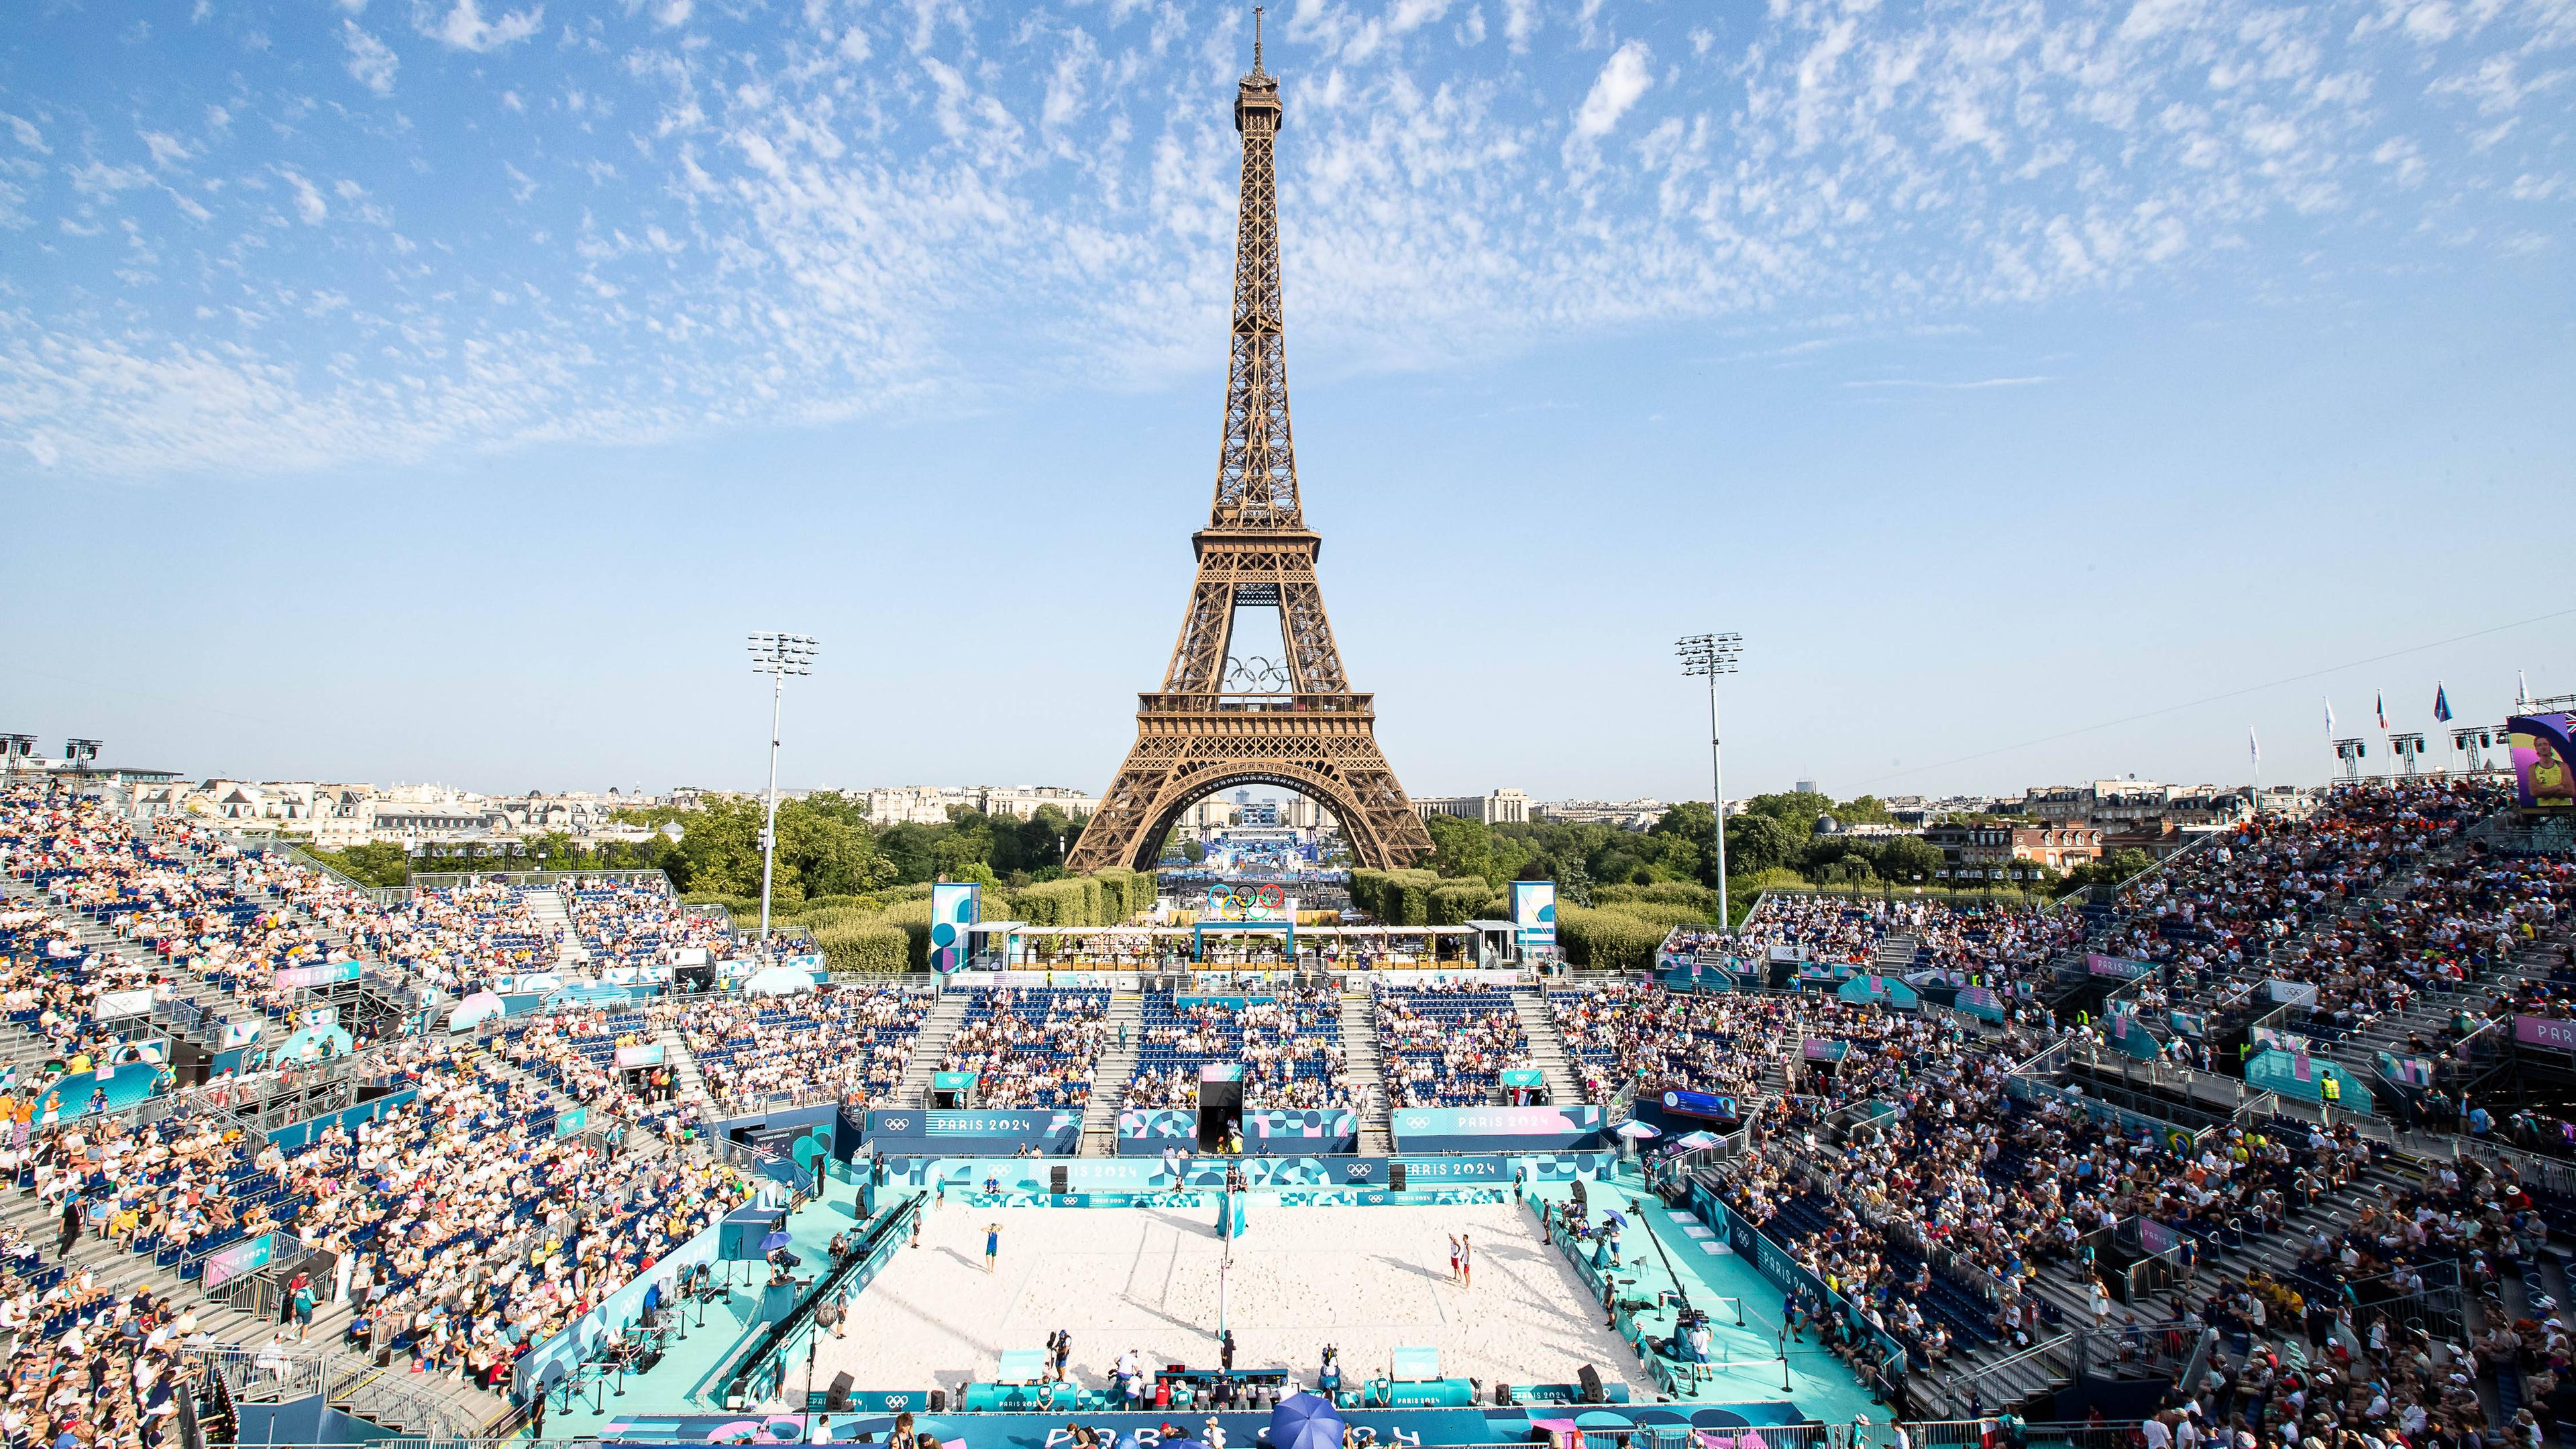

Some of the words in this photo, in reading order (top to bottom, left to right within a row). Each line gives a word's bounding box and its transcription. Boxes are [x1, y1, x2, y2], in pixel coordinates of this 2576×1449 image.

[2098, 960, 2123, 972] PARIS
[2126, 965, 2148, 975] 202
[2538, 1025, 2573, 1043] PAR
[938, 1120, 983, 1130] PARIS
[989, 1120, 1030, 1131] 2024
[1458, 1117, 1503, 1128] PARIS
[1509, 1116, 1548, 1127] 2024
[1041, 1166, 1088, 1177] PIS
[1094, 1166, 1137, 1178] 2024
[1453, 1163, 1495, 1175] 2024
[2144, 1230, 2167, 1245] PARIS
[1764, 1251, 1790, 1285] PARIS
[1516, 1391, 1541, 1399] PARIS
